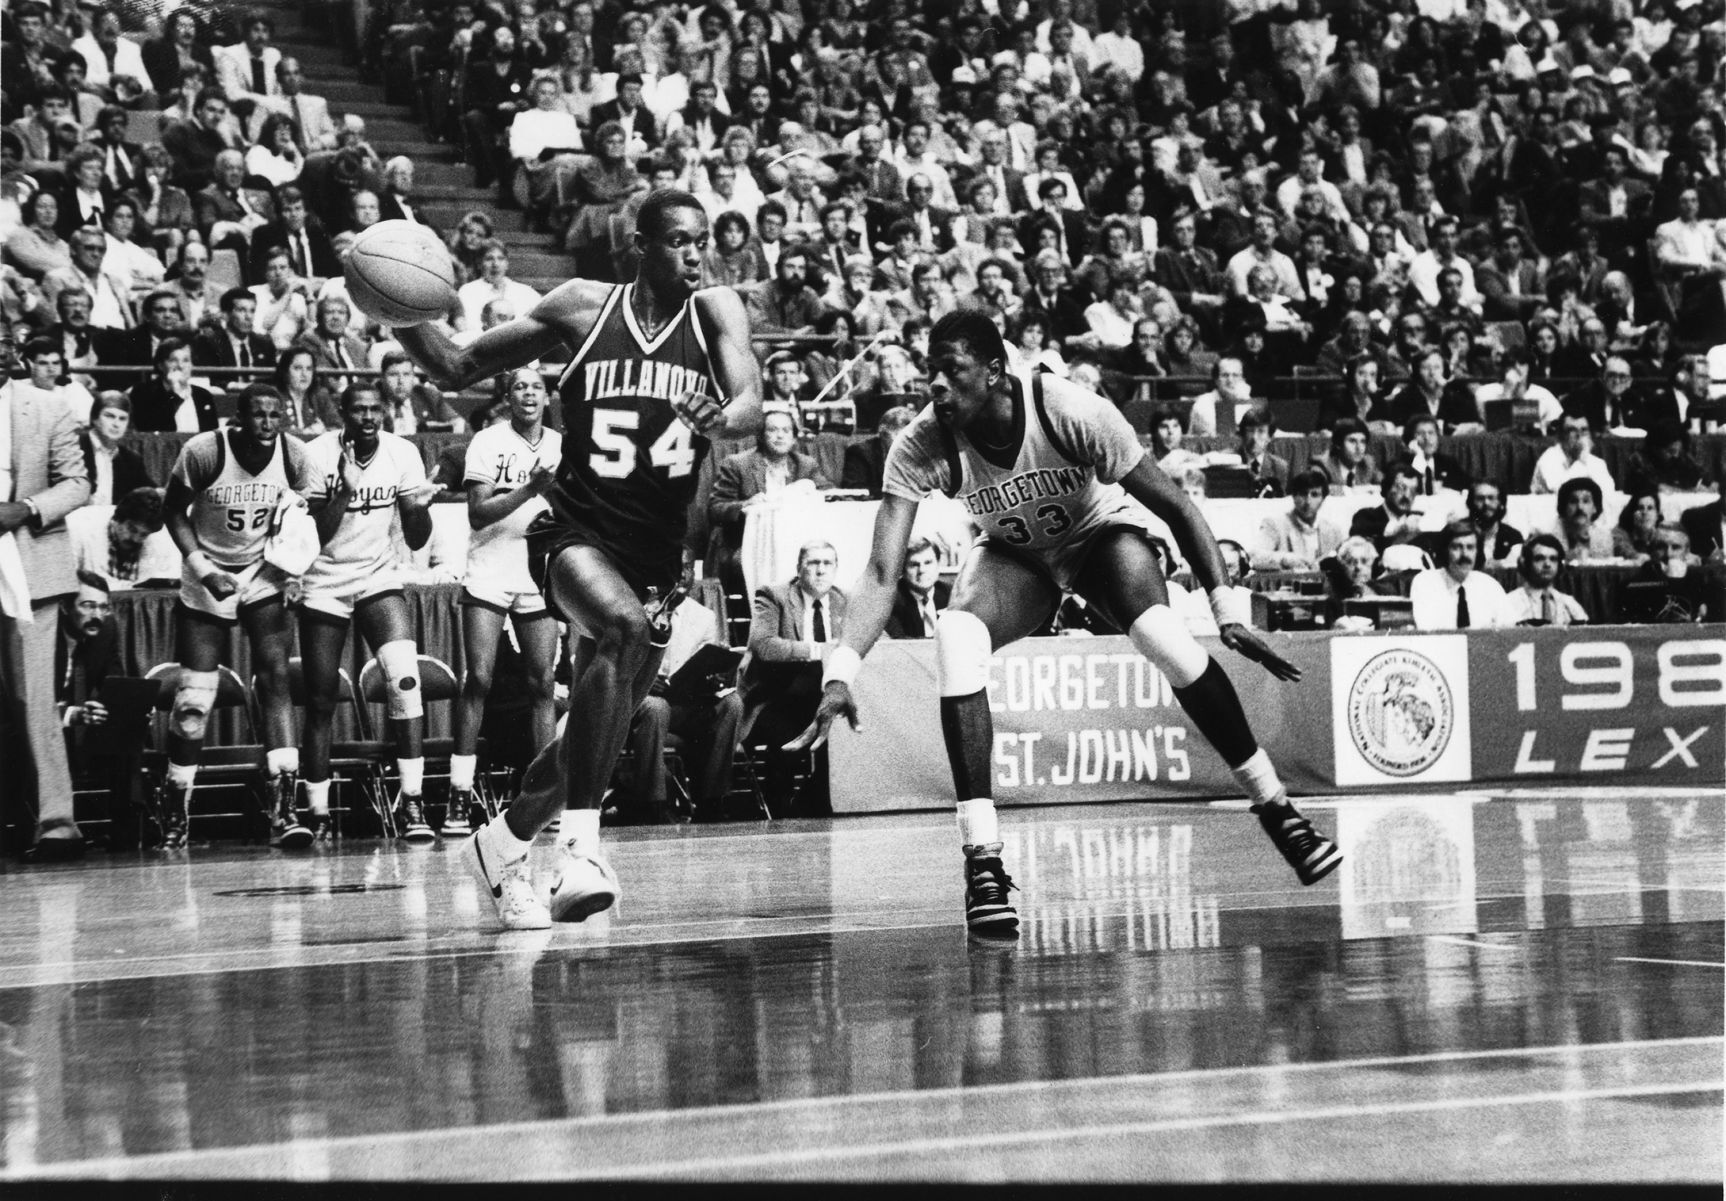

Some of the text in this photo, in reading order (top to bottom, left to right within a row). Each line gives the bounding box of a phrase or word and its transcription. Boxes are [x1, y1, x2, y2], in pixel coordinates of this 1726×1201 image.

[589, 407, 695, 479] 54
[206, 483, 282, 505] GEORGETO
[965, 466, 1087, 515] EORGETOWN
[222, 507, 269, 532] 52
[998, 503, 1073, 545] 33
[988, 654, 1182, 712] EORGETO
[993, 724, 1191, 787] ST. JOHN'S
[1514, 726, 1709, 773] LEX
